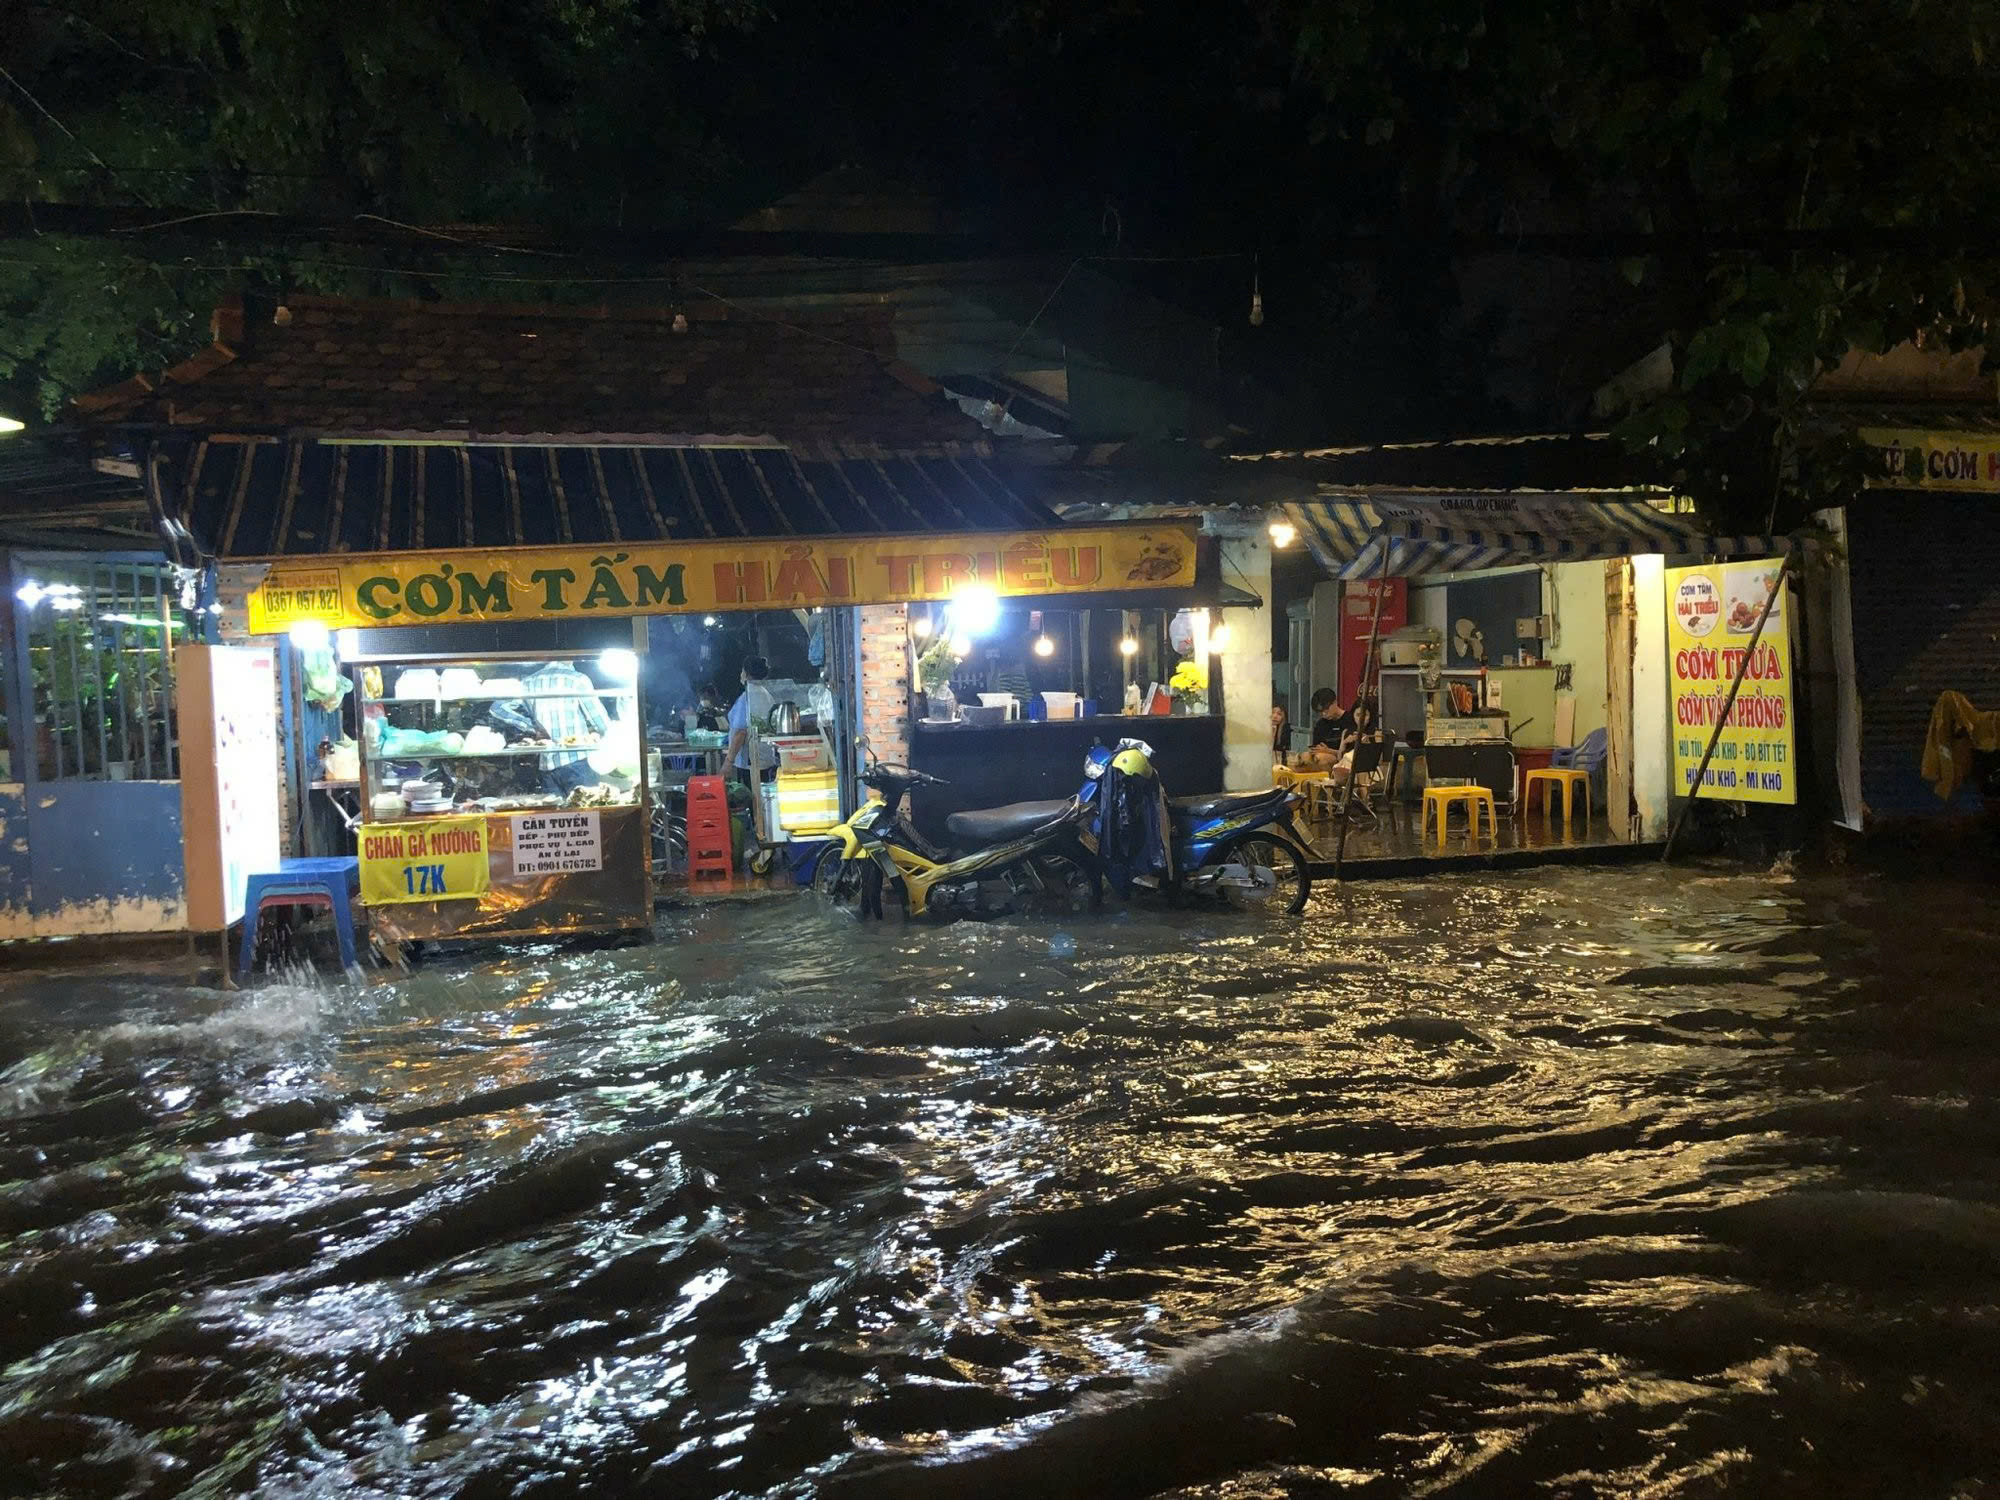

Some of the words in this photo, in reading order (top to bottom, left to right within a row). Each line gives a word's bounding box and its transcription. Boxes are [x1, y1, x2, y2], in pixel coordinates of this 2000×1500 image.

[1927, 446, 1978, 480] CƠM
[357, 563, 513, 619] CƠM
[531, 553, 689, 610] TẤM
[714, 544, 856, 603] HẢI
[877, 534, 1101, 597] TRIỀU
[266, 590, 293, 613] 0367
[1678, 598, 1692, 616] HẢI
[1676, 642, 1719, 680] CƠM
[1677, 689, 1705, 726] CƠM
[1737, 686, 1786, 729] PHÒNG
[1772, 739, 1787, 763] TẾT
[1762, 769, 1782, 791] KHÔ
[364, 831, 404, 860] CHÂN
[408, 829, 427, 858] GÀ
[431, 827, 481, 856] NƯỚNG
[403, 864, 447, 895] 17K
